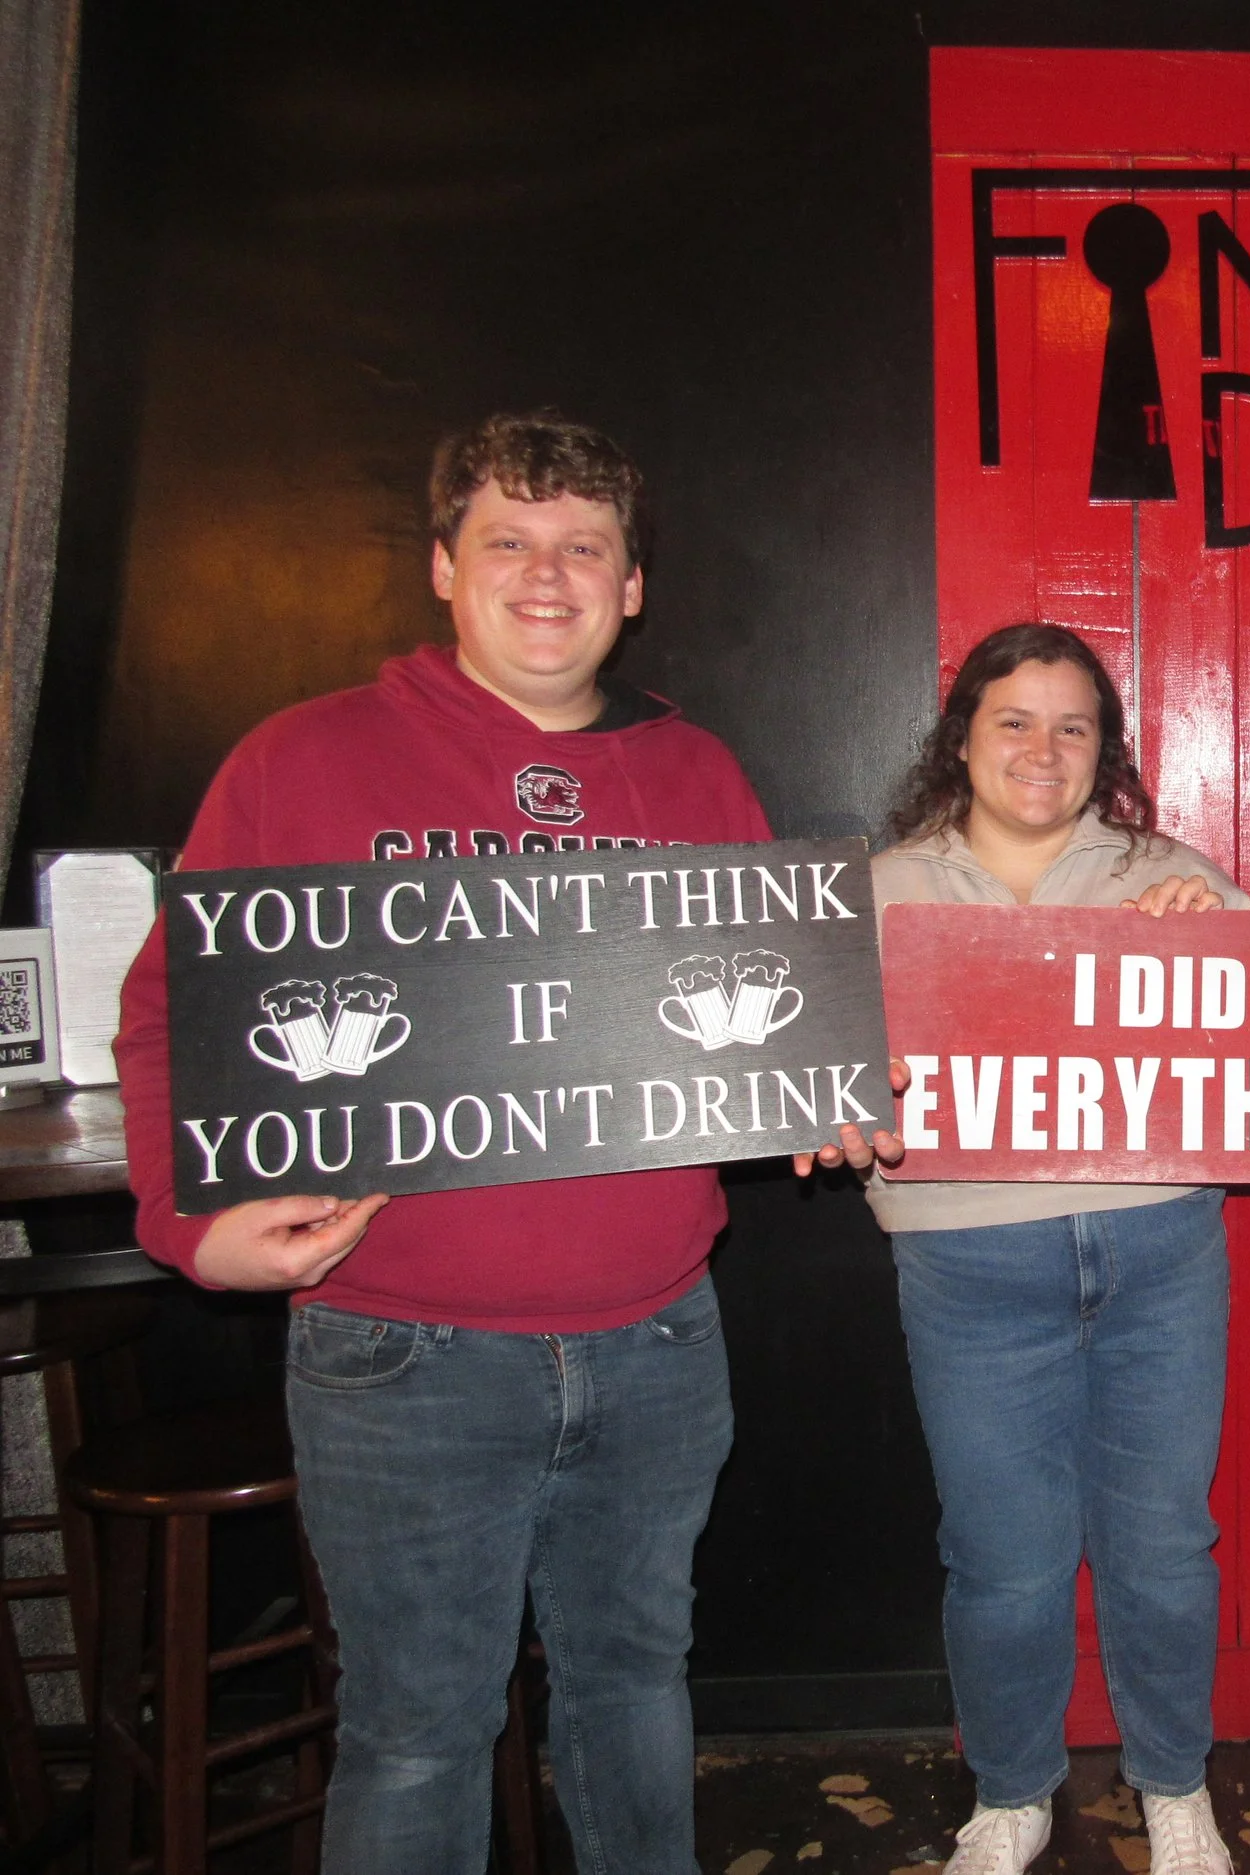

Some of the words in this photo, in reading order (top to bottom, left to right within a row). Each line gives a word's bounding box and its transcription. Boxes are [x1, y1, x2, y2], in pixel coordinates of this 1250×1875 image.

[183, 885, 356, 956] YOU
[381, 873, 606, 946] CAN'T
[627, 862, 858, 930] THINK
[507, 979, 573, 1045] IF
[1073, 953, 1096, 1028] I
[1118, 954, 1247, 1030] DID
[11, 1046, 33, 1060] ME
[183, 1105, 359, 1184] YOU
[384, 1085, 614, 1166] DON'T
[637, 1062, 878, 1143] DRINK
